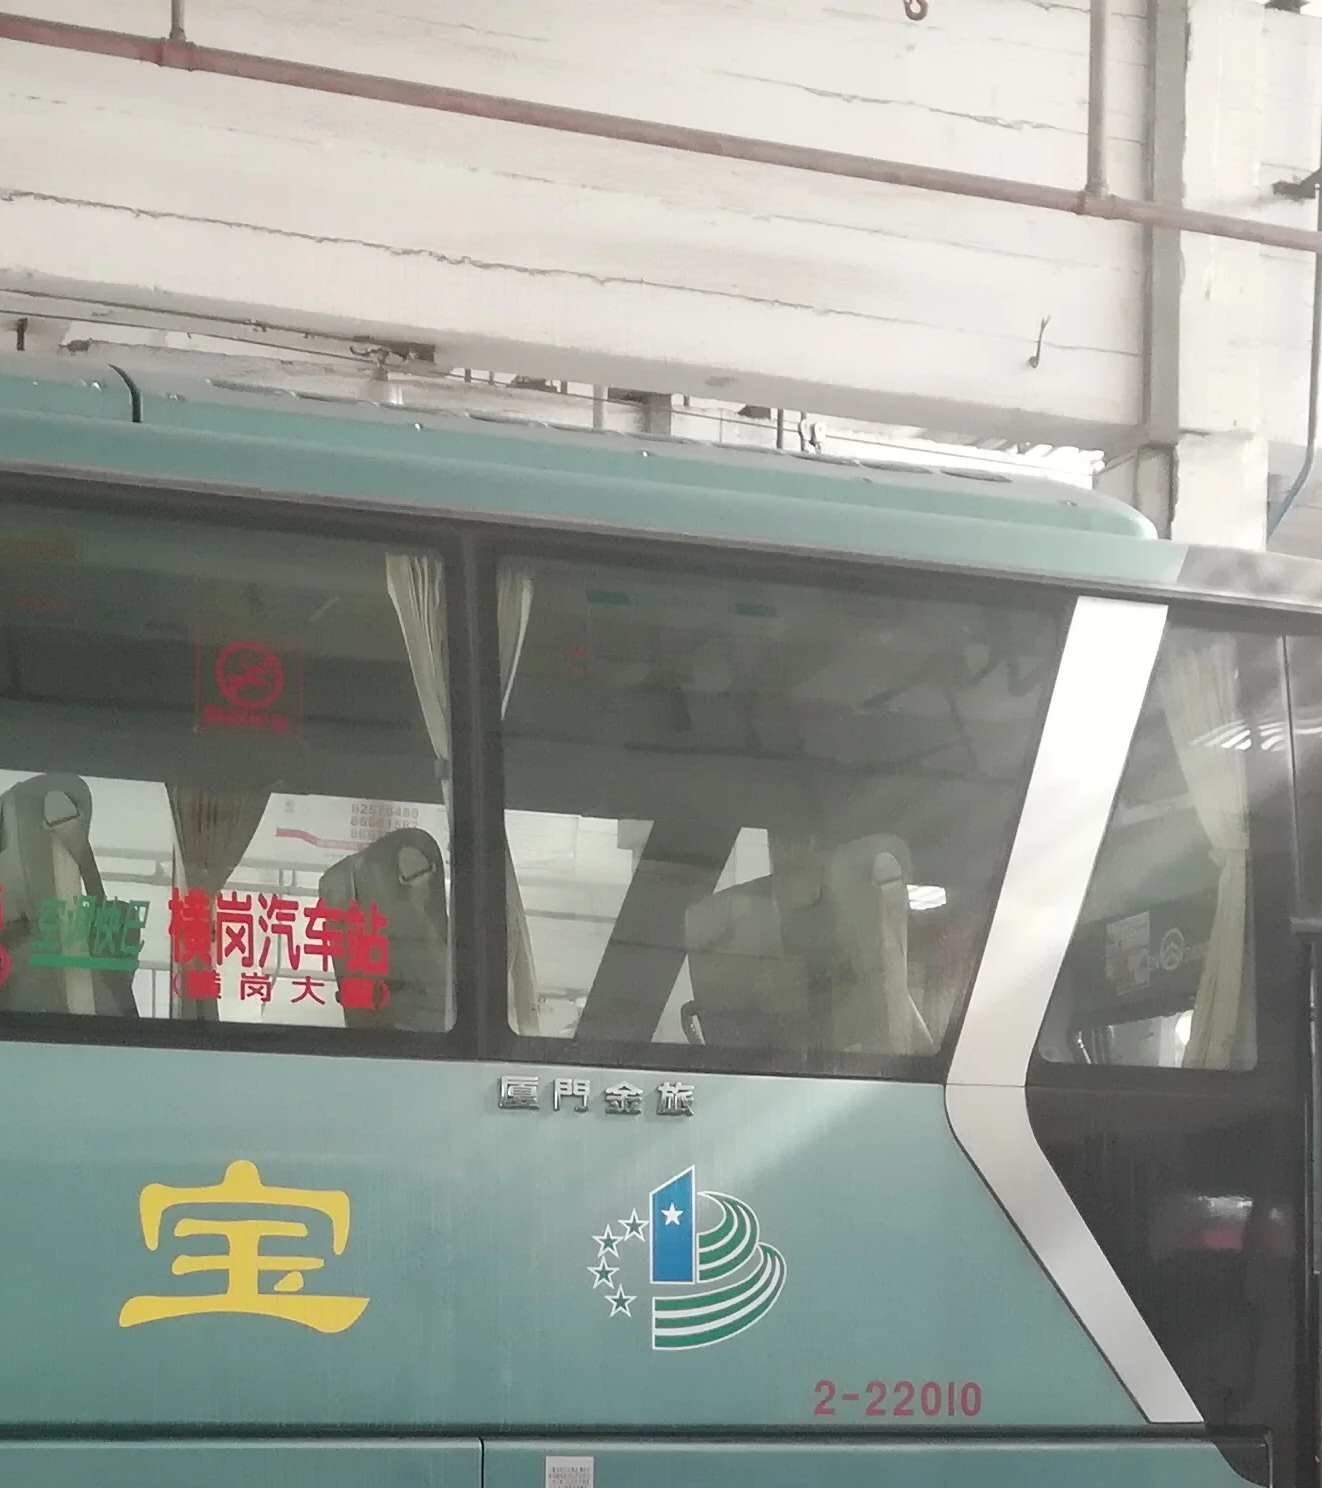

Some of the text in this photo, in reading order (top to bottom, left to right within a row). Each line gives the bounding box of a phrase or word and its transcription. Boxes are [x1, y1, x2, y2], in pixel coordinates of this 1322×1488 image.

[167, 887, 390, 976] 横岗汽车站
[813, 1379, 983, 1418] 2-22010
